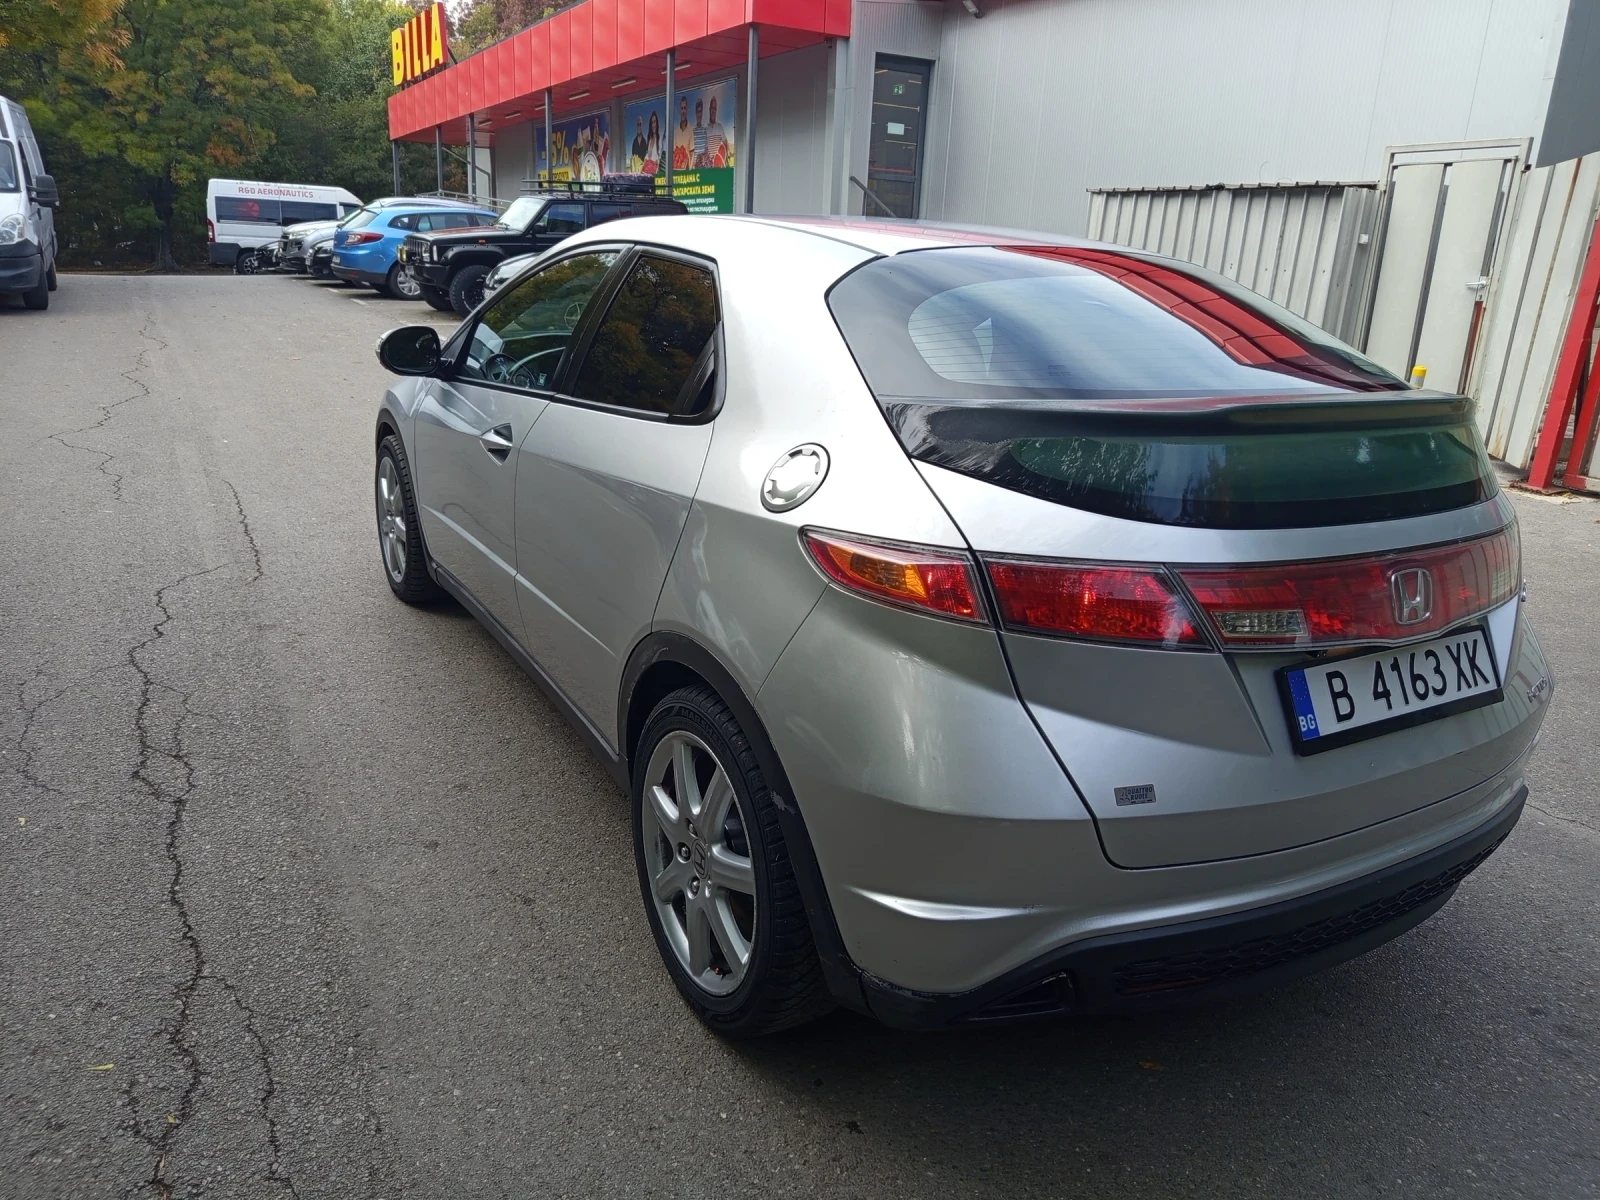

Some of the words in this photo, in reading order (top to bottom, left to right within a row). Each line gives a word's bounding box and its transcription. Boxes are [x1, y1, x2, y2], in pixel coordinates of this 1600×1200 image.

[392, 2, 444, 86] BILLA
[238, 187, 256, 195] R&D
[257, 188, 314, 198] AERONAUTICS
[1325, 670, 1355, 723] B
[1373, 648, 1447, 710] 4163
[1445, 639, 1490, 692] XK
[1298, 714, 1316, 732] BG
[1127, 787, 1153, 795] QUATTRO
